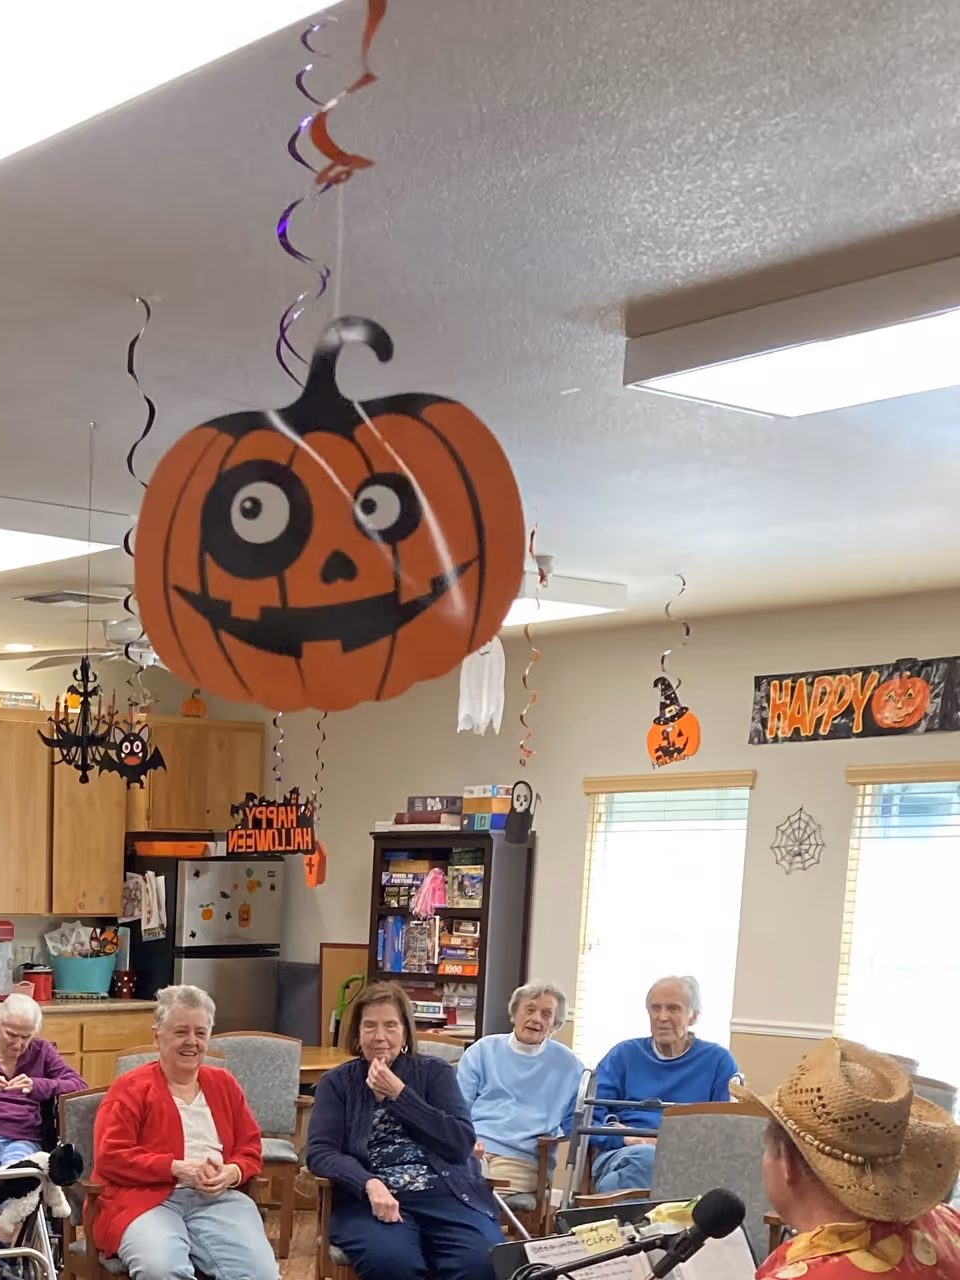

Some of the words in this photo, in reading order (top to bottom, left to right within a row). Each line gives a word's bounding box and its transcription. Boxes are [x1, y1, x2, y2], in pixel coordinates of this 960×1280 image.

[766, 671, 879, 738] HAPPY
[445, 964, 462, 974] 1000
[586, 1233, 617, 1247] CLAPS
